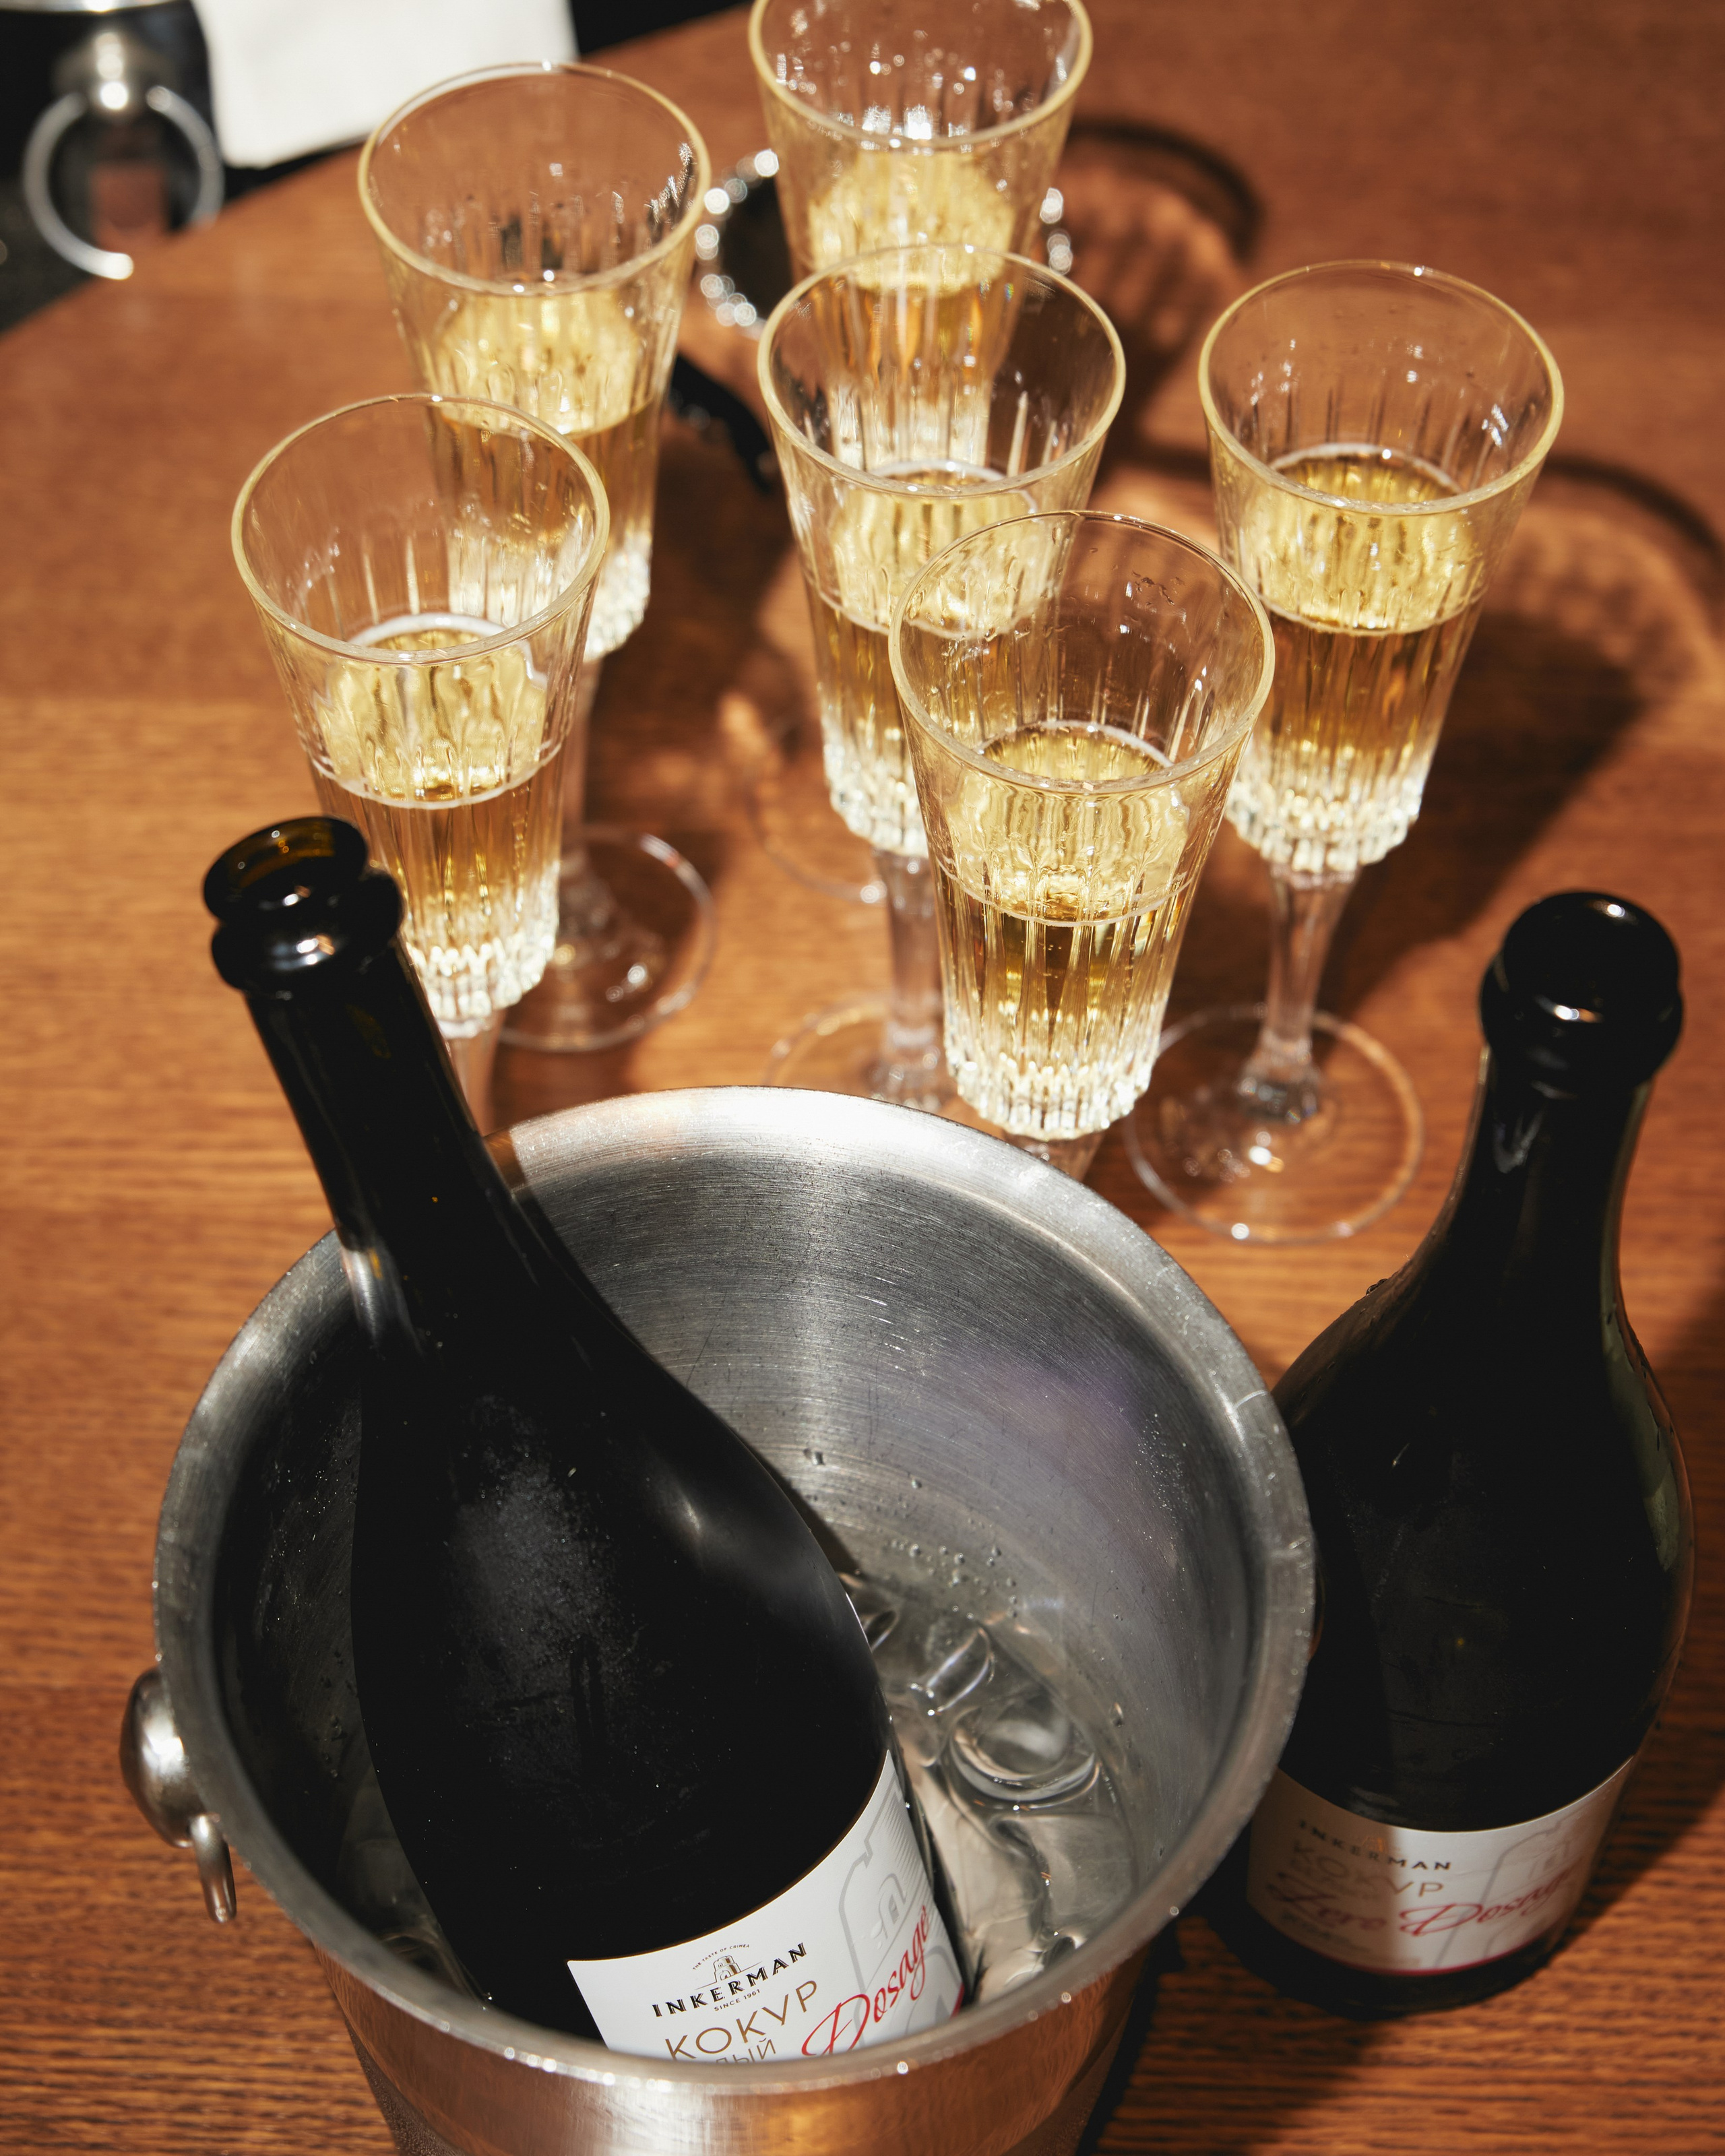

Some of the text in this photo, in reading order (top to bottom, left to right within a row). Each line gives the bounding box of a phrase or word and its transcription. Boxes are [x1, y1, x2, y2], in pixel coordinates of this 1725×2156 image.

[1299, 1820, 1451, 1870] INKERMAN
[652, 1942, 807, 2018] INKERMAN
[692, 1961, 701, 1971] THE
[702, 1951, 718, 1962] TASTE
[801, 1905, 929, 2056] Dosage
[664, 1980, 818, 2061] КОКУР
[714, 1989, 761, 2012] SINCE 1961
